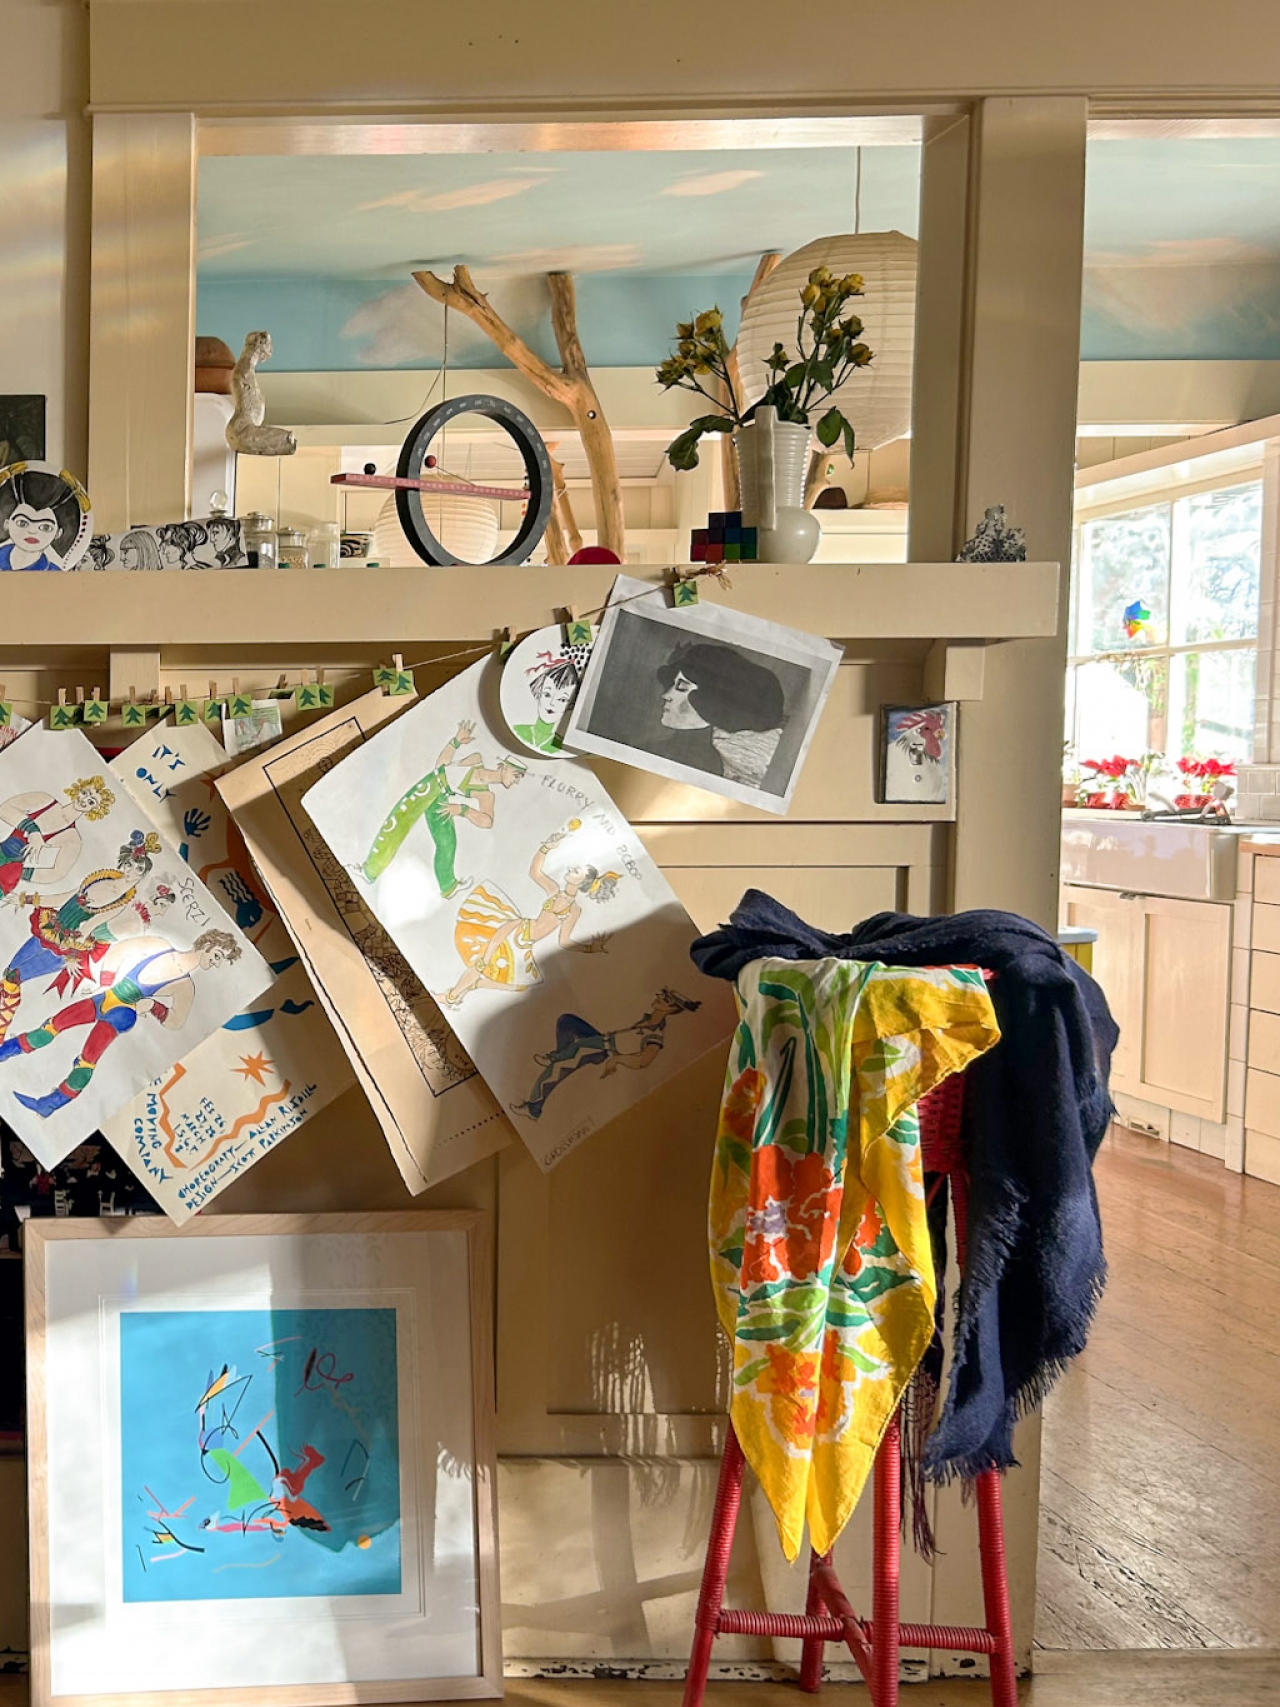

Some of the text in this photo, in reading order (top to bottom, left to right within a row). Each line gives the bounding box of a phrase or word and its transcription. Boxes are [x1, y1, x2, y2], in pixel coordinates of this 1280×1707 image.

[136, 767, 178, 804] ONLY
[540, 773, 596, 810] FLURRY
[146, 1092, 163, 1150] MOVING
[180, 1112, 207, 1145] MARCH
[248, 1116, 277, 1140] ALLAN
[258, 1108, 308, 1151] PARKINSON
[133, 1117, 175, 1184] COMPANY
